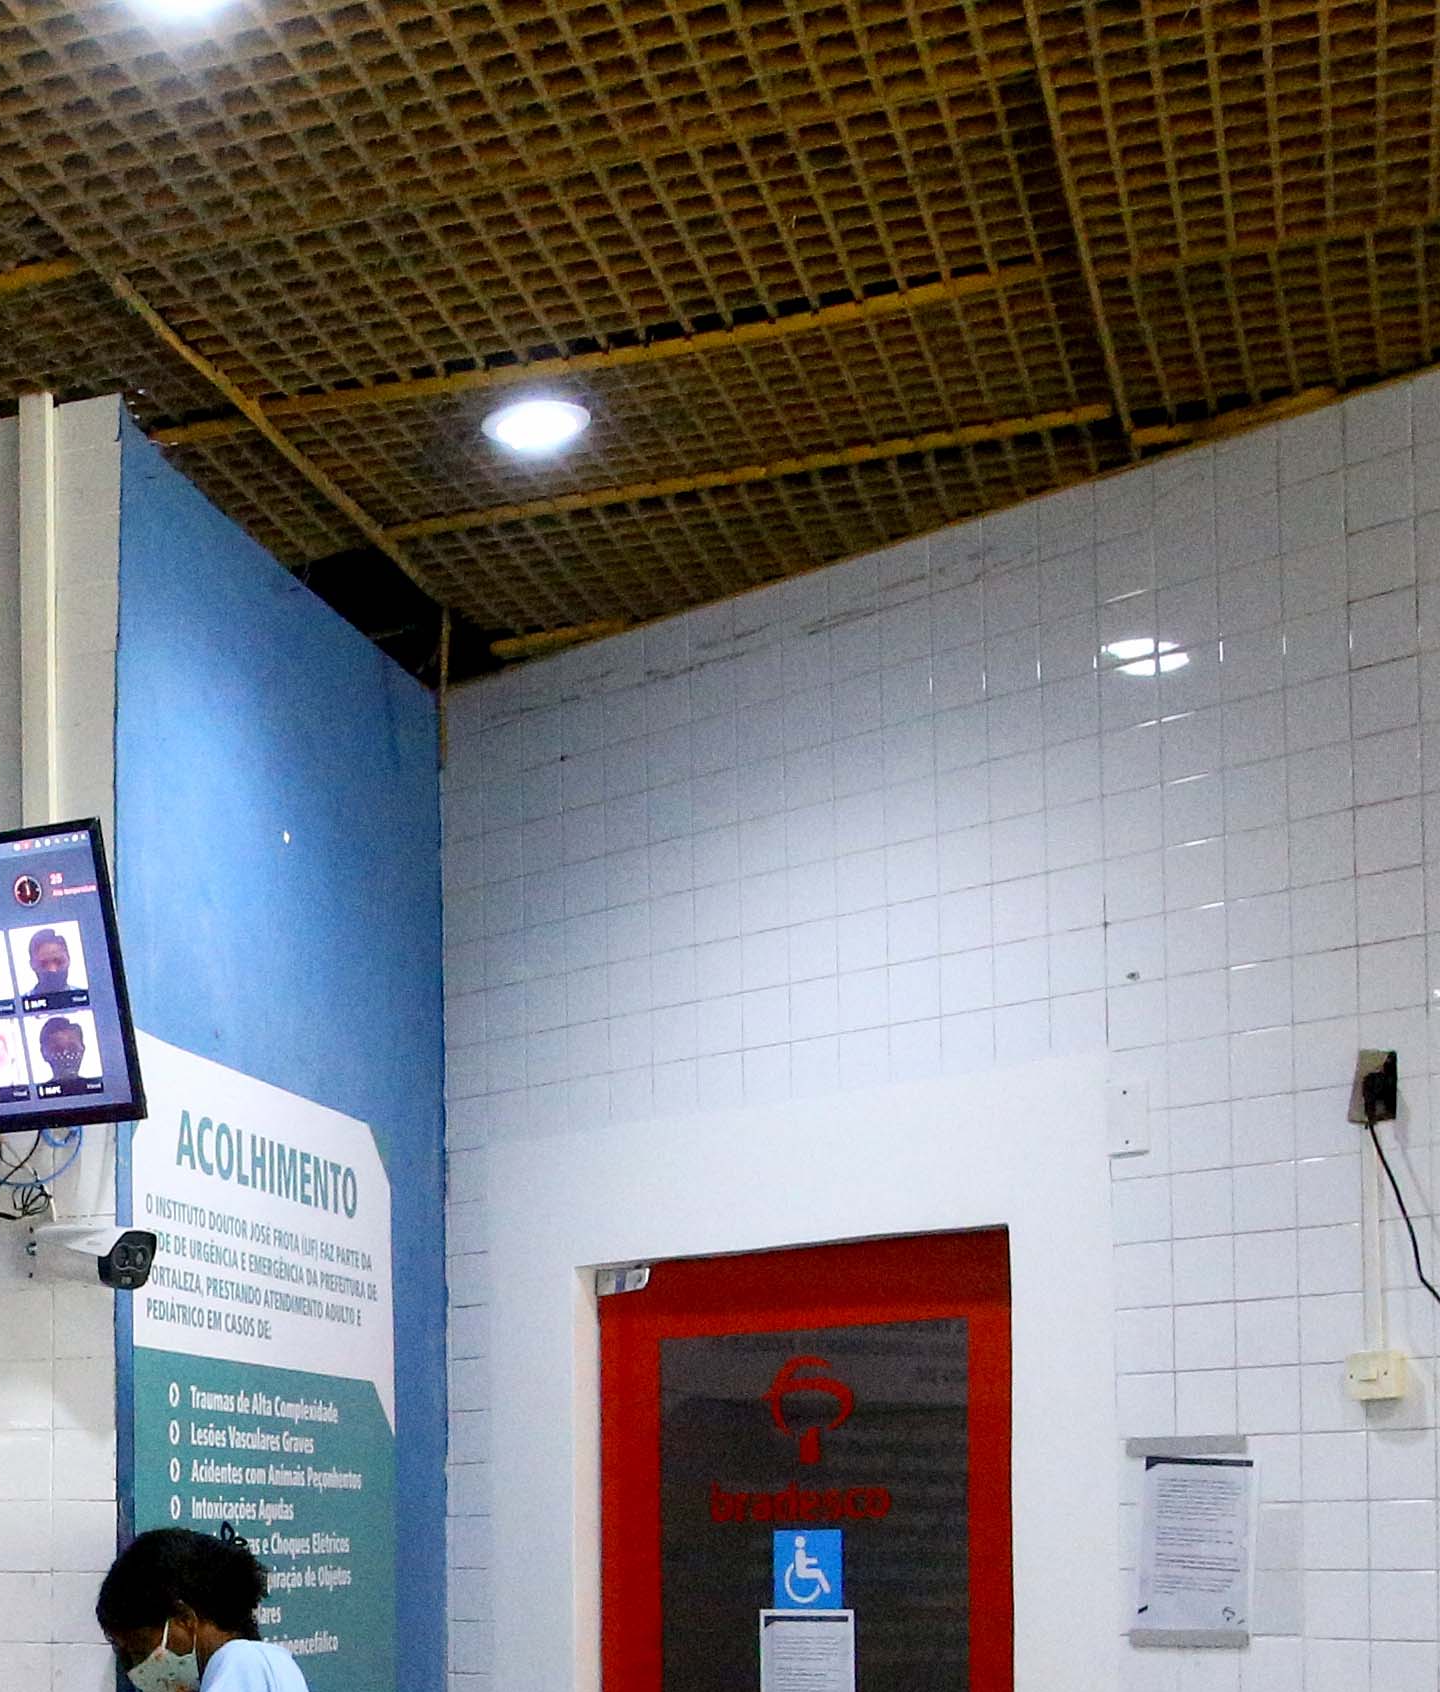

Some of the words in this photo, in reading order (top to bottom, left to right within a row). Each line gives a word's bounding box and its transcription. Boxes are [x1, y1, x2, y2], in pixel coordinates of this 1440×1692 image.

[176, 1109, 358, 1220] ACOLHIMENTO
[146, 1193, 153, 1214] O
[156, 1195, 206, 1229] INSTITUTO
[209, 1210, 248, 1241] DOUTOR
[250, 1219, 271, 1246] JOSÉ
[273, 1228, 300, 1253] FROTA
[320, 1241, 335, 1262] FAZ
[336, 1246, 360, 1269] PARTE
[361, 1252, 373, 1272] DA
[174, 1235, 187, 1258] DE
[190, 1238, 239, 1270] URGÊNCIA
[241, 1252, 246, 1271] E
[249, 1253, 305, 1286] EMERGÊNCIA
[306, 1267, 319, 1288] DA
[320, 1271, 366, 1300] PREFEITURA
[367, 1282, 378, 1302] DE
[151, 1265, 204, 1298] ORTALEZA,
[206, 1277, 261, 1306] PRESTANDO
[263, 1289, 324, 1320] ATENDIMENTO
[325, 1302, 356, 1326] ADULTO
[357, 1308, 362, 1328] E
[146, 1296, 205, 1329] PEDIÁTRICO
[207, 1309, 222, 1332] EM
[224, 1313, 256, 1338] CASOS
[190, 1385, 235, 1412] Traumas
[237, 1389, 250, 1415] de
[252, 1391, 272, 1417] Alta
[274, 1395, 339, 1424] Complexidade
[191, 1421, 227, 1447] Lesões
[228, 1425, 280, 1451] Vasculares
[282, 1430, 315, 1454] Graves
[191, 1459, 243, 1484] Acidentes
[245, 1466, 267, 1486] com
[268, 1463, 305, 1487] Animais
[307, 1465, 363, 1493] Peçonhentos
[191, 1495, 257, 1524] Intoxicações
[258, 1497, 295, 1525] Agudas
[710, 1479, 892, 1523] bradesco
[262, 1539, 269, 1555] e
[271, 1531, 311, 1560] Choques
[312, 1531, 351, 1554] Elétricos
[266, 1565, 303, 1595] piração
[304, 1566, 317, 1587] de
[318, 1564, 352, 1592] Objetos
